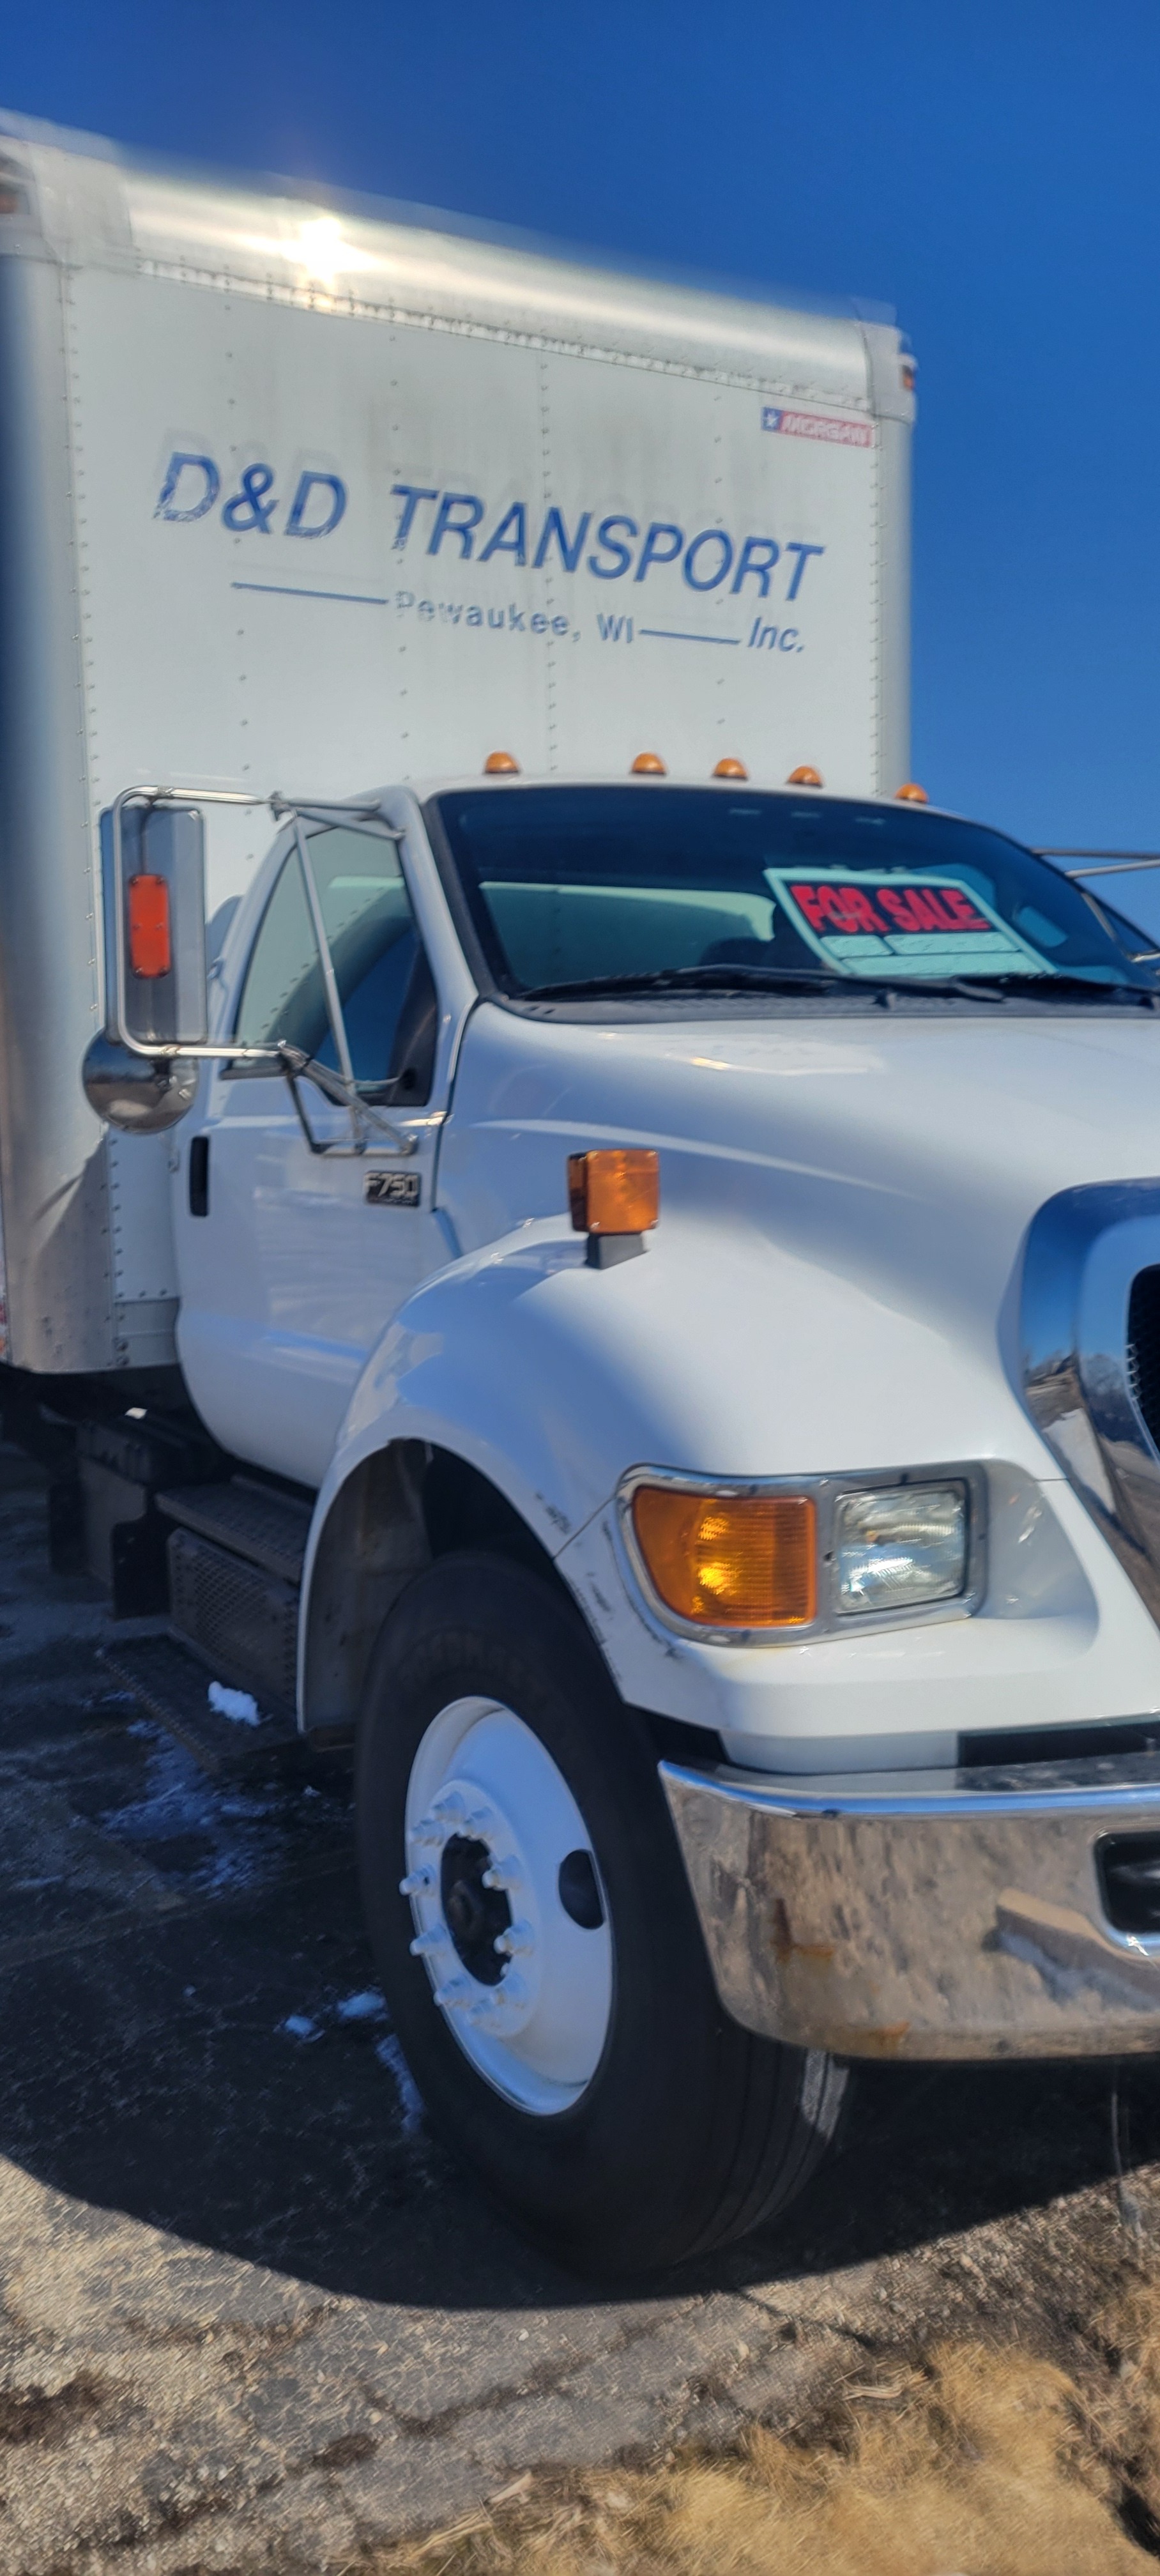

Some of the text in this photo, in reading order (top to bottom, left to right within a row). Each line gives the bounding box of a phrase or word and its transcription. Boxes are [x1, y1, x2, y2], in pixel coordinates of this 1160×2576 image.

[153, 451, 827, 602] D&D TRANSPORT
[394, 589, 805, 653] Pewaukee, WI Inc.
[790, 884, 992, 933] FOR SALE
[363, 1171, 419, 1198] F750
